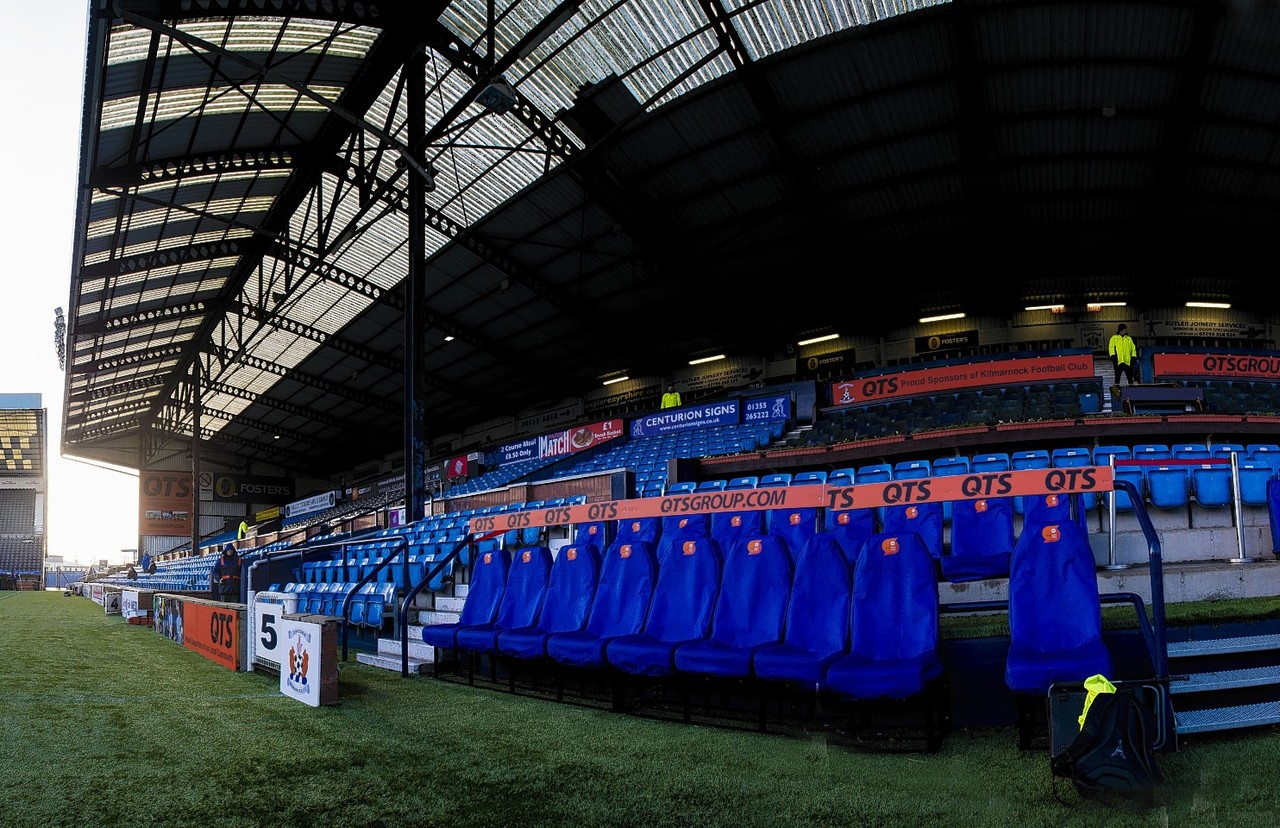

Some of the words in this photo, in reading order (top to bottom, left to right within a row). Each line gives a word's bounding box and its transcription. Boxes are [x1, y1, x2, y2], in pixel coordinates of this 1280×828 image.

[941, 337, 969, 345] FOSTER'S
[819, 356, 844, 365] FOSTER'S
[862, 376, 898, 397] QTS
[901, 378, 925, 387] Proud
[928, 373, 968, 385] Sponsors
[970, 371, 978, 379] of
[980, 366, 1029, 378] Kilmarnock
[1031, 364, 1065, 373] Football
[1068, 362, 1088, 371] Club
[747, 402, 767, 411] 01355
[521, 418, 539, 428] PRESS
[542, 414, 558, 423] AREA
[646, 410, 702, 427] CENTURION
[705, 404, 736, 417] SIGNS
[745, 411, 769, 420] 265222
[603, 421, 612, 431] £1
[505, 443, 522, 452] Course
[522, 438, 537, 447] Meal
[540, 430, 570, 458] MATCH
[505, 451, 519, 460] £8.50
[519, 449, 532, 458] Only
[143, 476, 191, 498] QTS
[240, 483, 290, 496] FOSTER'S
[882, 480, 932, 503] QTS
[962, 472, 1012, 498] QTS
[1044, 468, 1097, 493] QTS
[660, 489, 787, 513] QTSGROUP.COM
[474, 517, 495, 532] QTS
[507, 512, 531, 528] QTS
[544, 507, 571, 524] QTS
[588, 502, 619, 520] QTS
[111, 598, 118, 610] 4
[210, 612, 234, 649] QTS
[260, 614, 278, 651] 5
